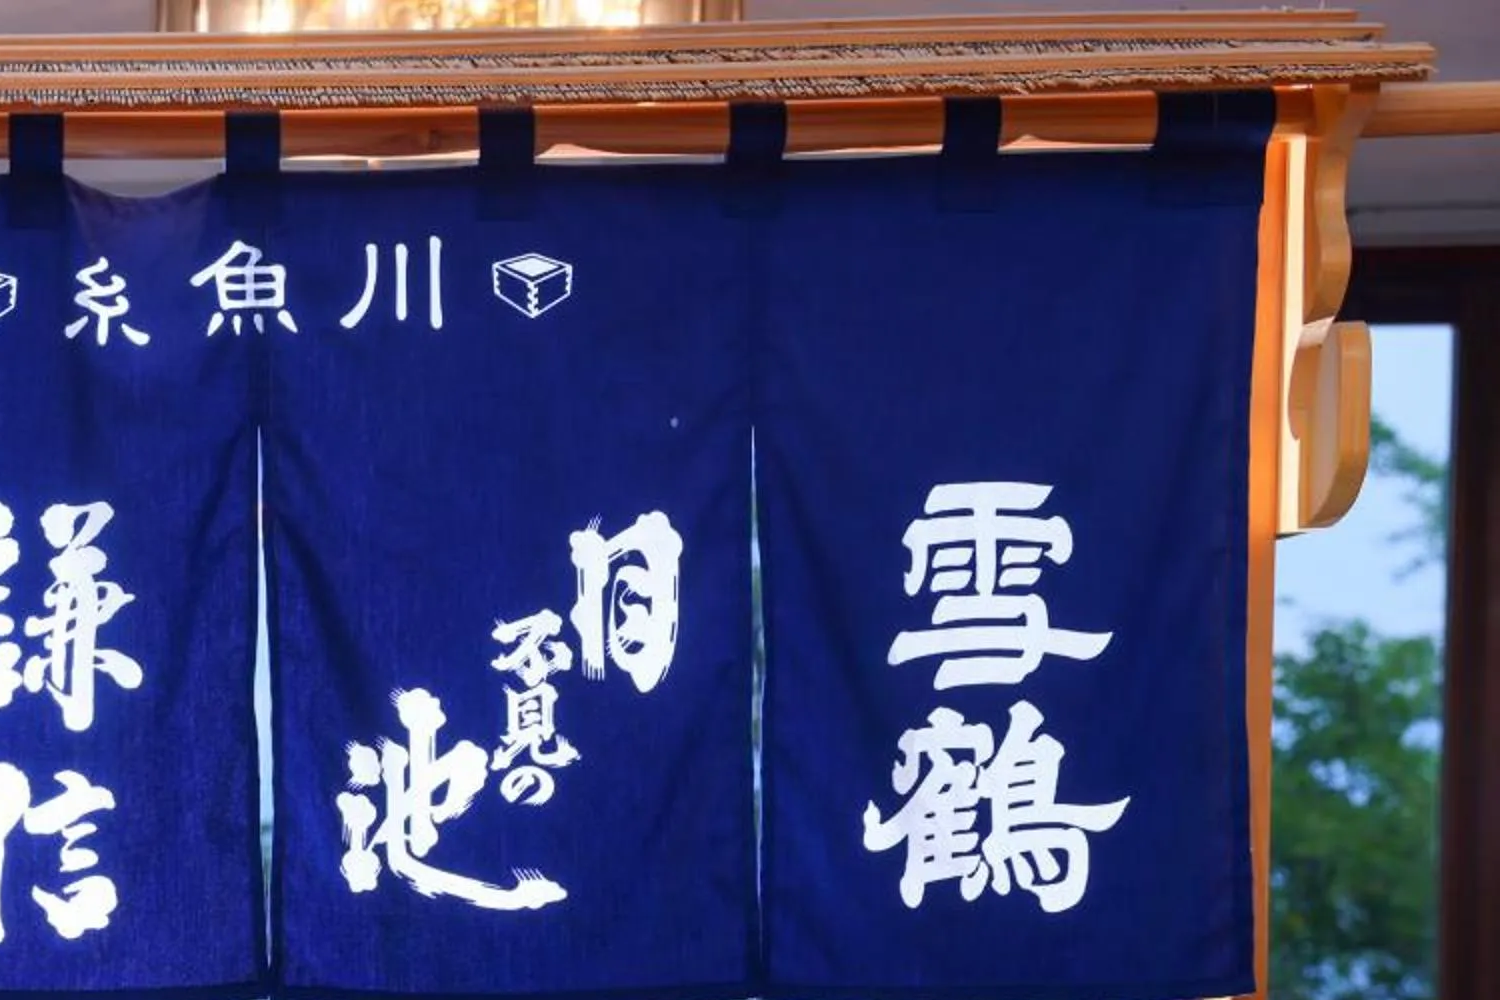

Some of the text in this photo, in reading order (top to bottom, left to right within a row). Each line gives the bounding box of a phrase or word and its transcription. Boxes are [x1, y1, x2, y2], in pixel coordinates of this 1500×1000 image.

[66, 237, 443, 346] 糸魚川
[863, 481, 1131, 913] 雪鶴
